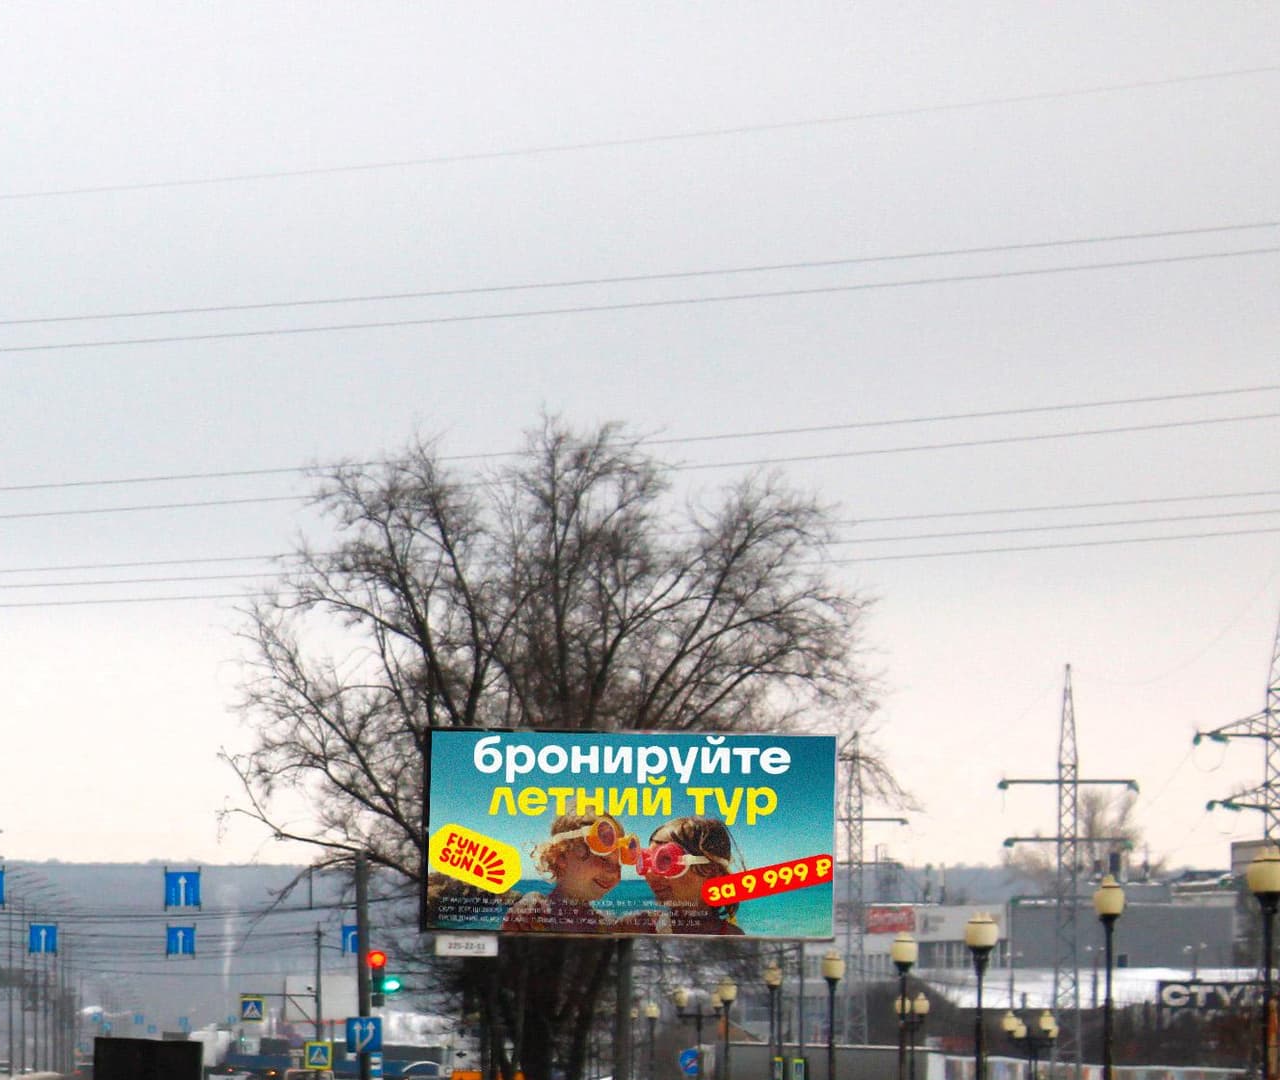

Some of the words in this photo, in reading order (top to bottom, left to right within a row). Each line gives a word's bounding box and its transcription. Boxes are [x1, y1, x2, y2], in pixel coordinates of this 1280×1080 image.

[473, 735, 792, 784] бронируйте
[488, 776, 672, 816] летний
[686, 786, 778, 826] тур
[439, 847, 474, 872] SUN
[447, 832, 480, 857] FUN
[707, 883, 736, 901] за
[741, 874, 756, 893] 9
[763, 863, 809, 889] 999
